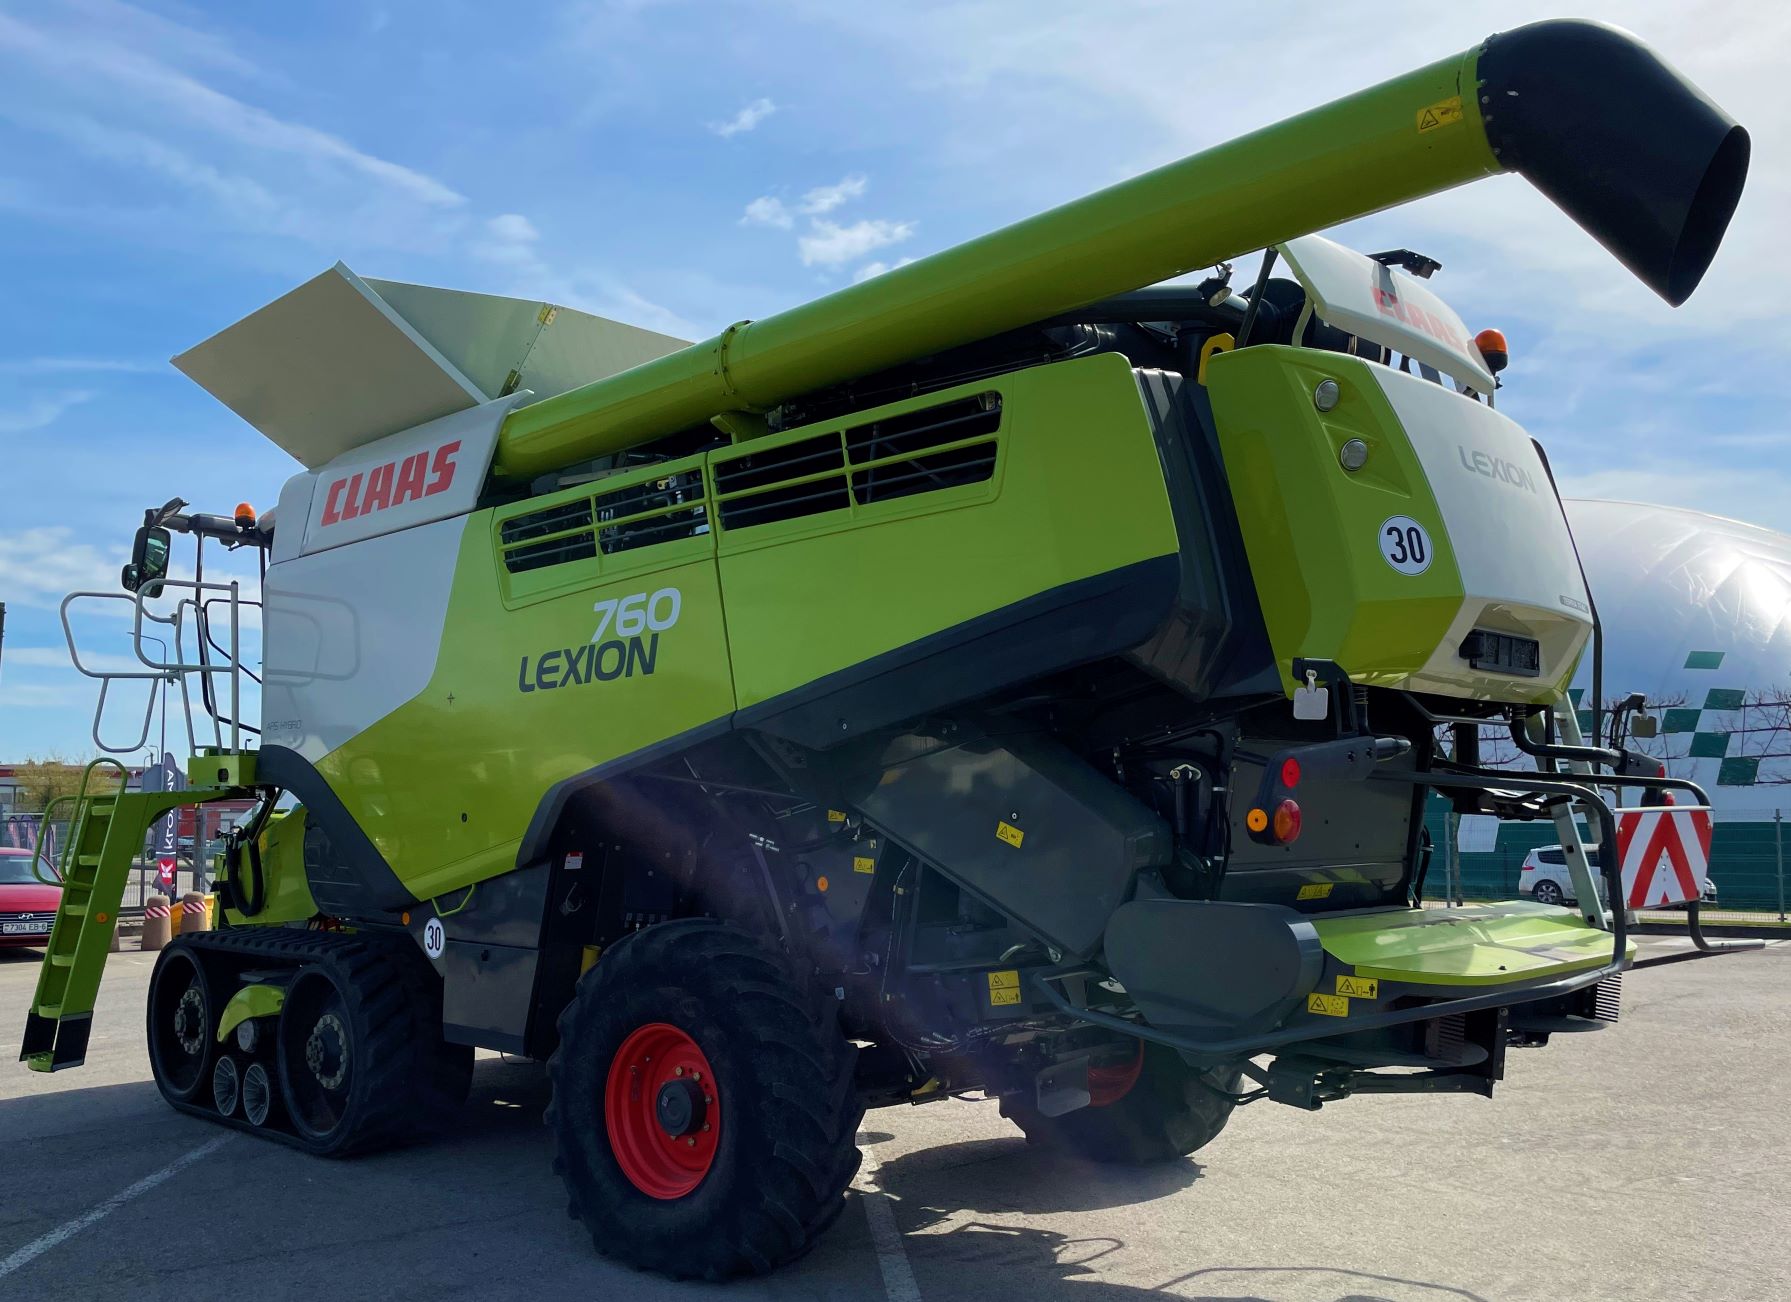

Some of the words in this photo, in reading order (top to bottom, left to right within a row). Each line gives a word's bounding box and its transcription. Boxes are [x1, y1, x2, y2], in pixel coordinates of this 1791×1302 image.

[1370, 287, 1468, 356] CLAAS
[321, 439, 462, 527] CLAAS
[1458, 445, 1536, 494] LEXION
[1386, 526, 1425, 564] 30
[590, 587, 682, 643] 760
[518, 632, 659, 693] LEXION
[426, 924, 441, 951] 30
